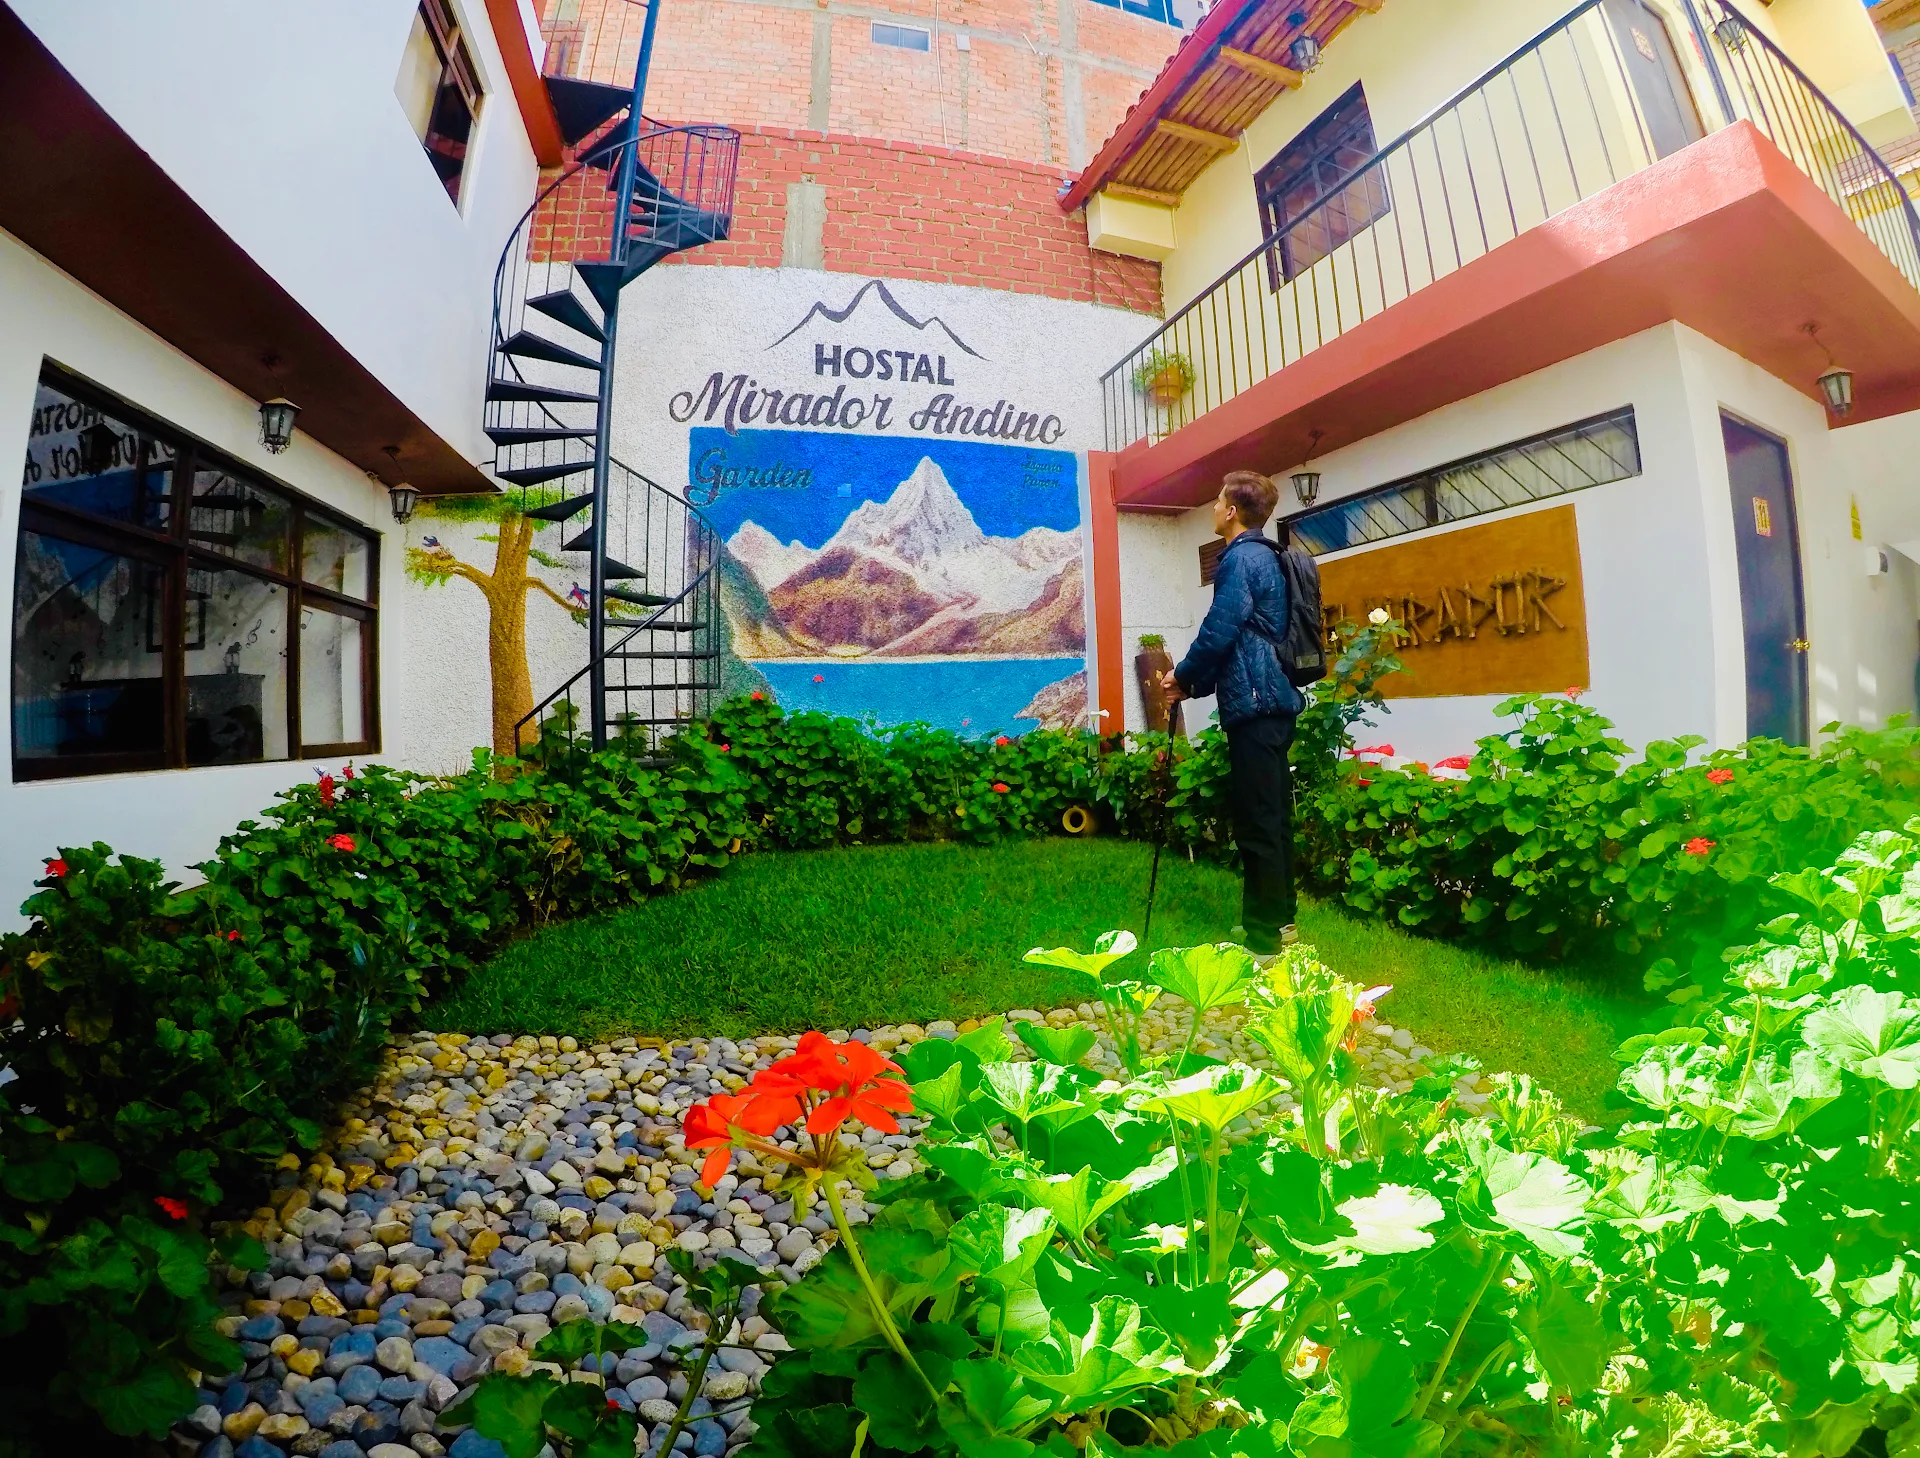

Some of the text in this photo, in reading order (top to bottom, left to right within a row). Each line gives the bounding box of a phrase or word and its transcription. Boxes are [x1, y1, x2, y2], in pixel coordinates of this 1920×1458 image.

[815, 343, 954, 386] HOSTAL
[668, 371, 1067, 445] Mirador Andino
[683, 447, 814, 506] Garden
